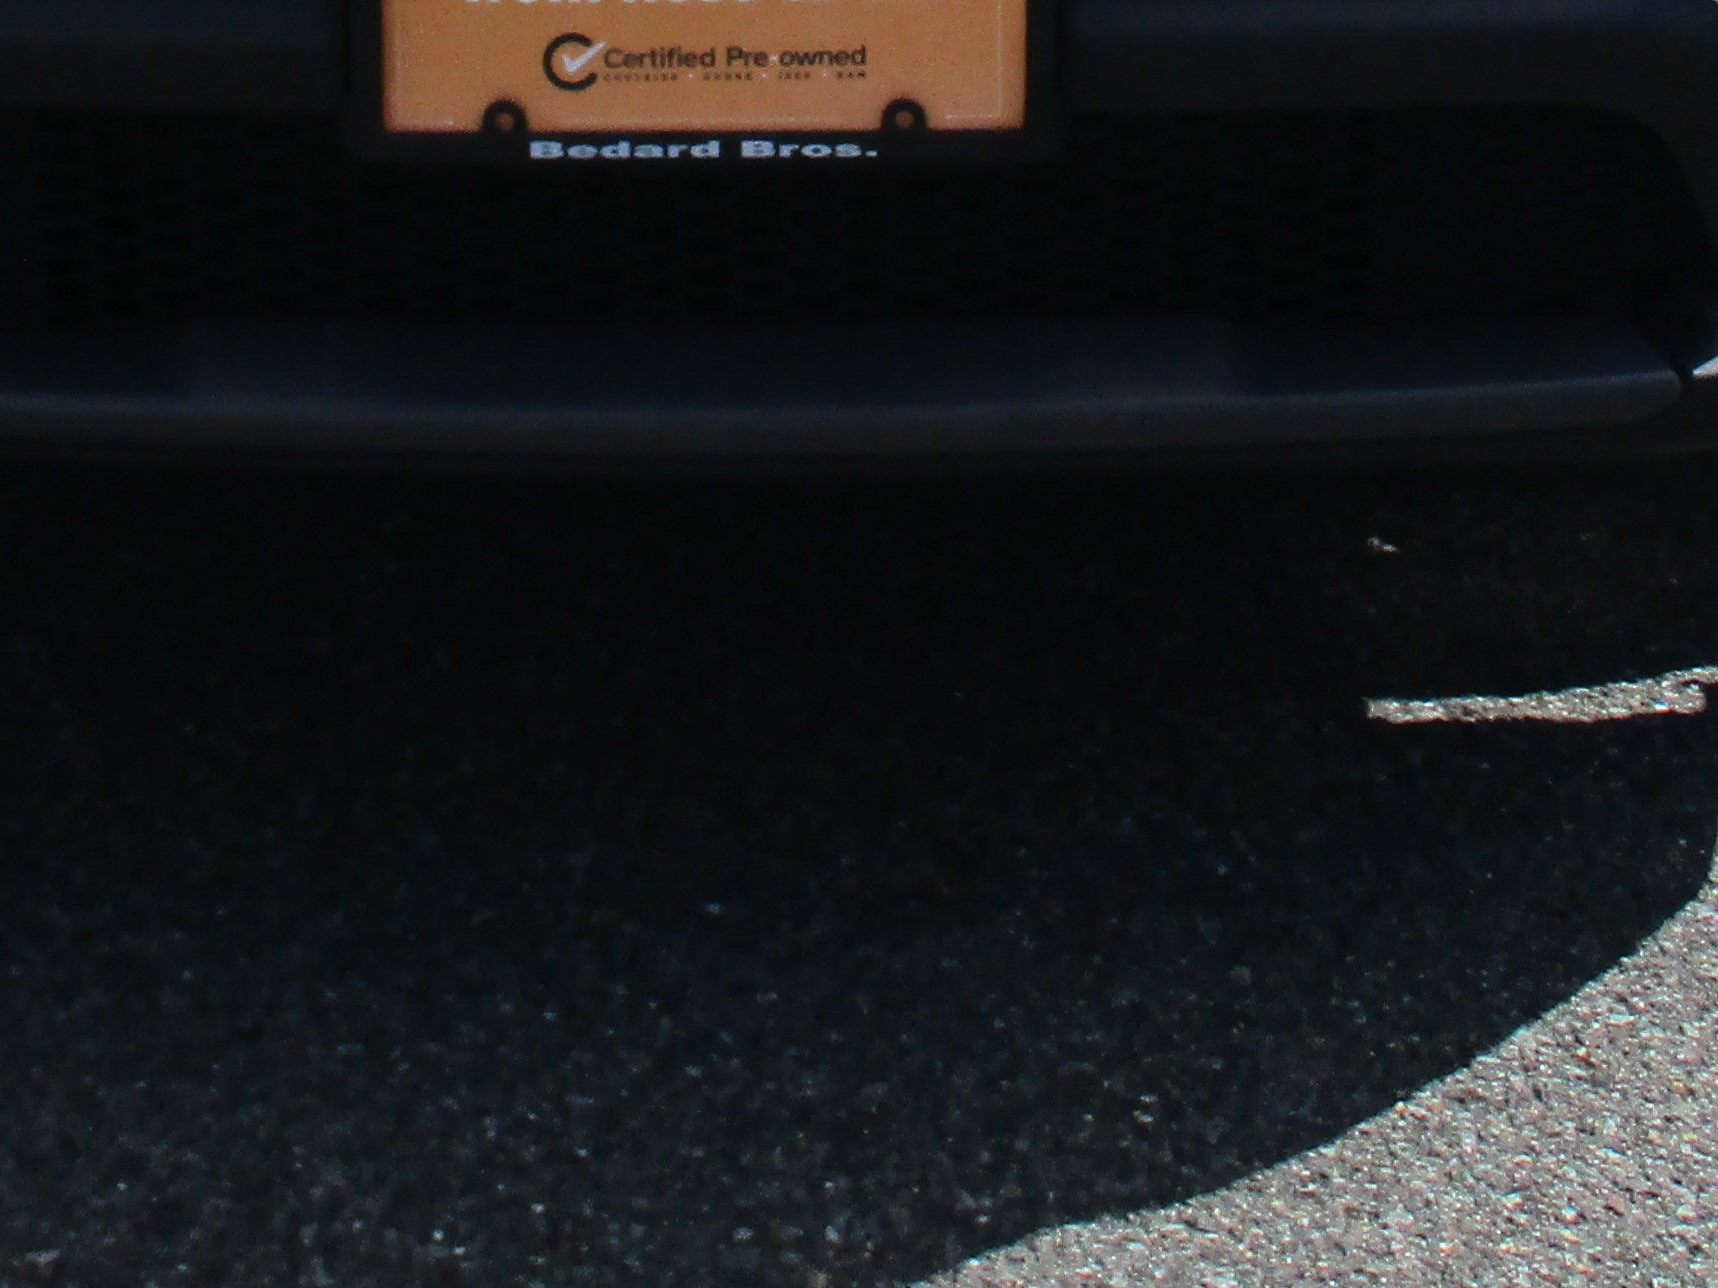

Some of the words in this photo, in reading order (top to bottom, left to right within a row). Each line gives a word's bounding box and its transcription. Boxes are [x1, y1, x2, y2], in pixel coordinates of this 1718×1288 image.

[603, 46, 716, 70] Certified
[529, 139, 721, 160] Bedard
[740, 139, 878, 159] Bros.
